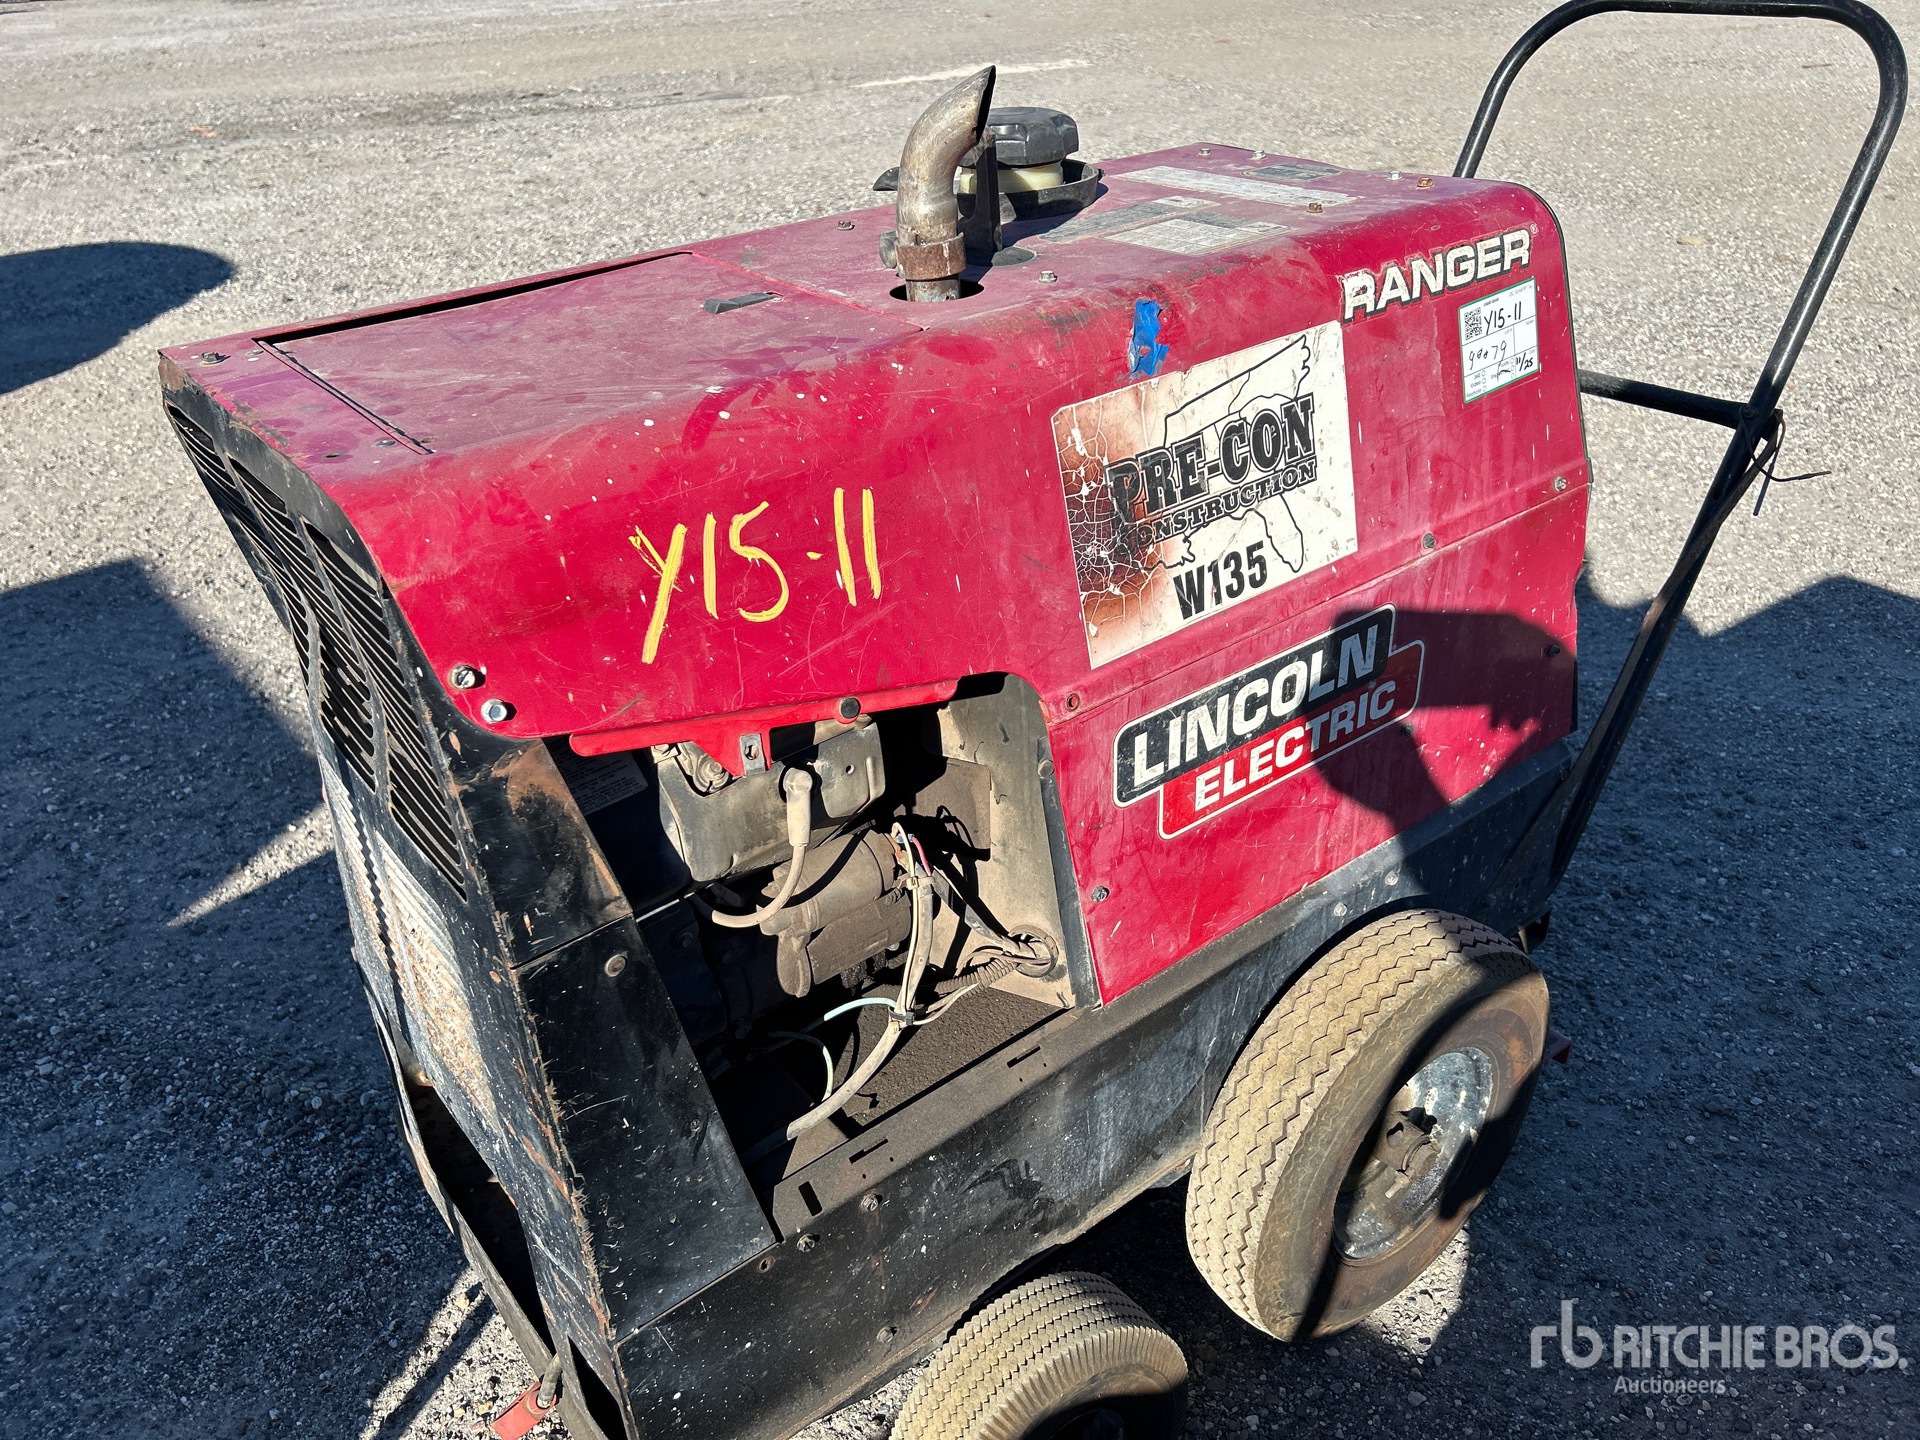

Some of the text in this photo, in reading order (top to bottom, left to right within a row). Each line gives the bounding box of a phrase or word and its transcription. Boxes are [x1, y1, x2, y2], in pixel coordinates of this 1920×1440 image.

[1342, 229, 1532, 322] RANGER
[1484, 301, 1521, 335] Y15-11
[1104, 392, 1314, 524] PRE-CON
[1122, 460, 1317, 548] ONSTRUCTION
[628, 487, 882, 664] Y15-11
[1173, 540, 1268, 620] W135
[1133, 624, 1378, 788] LINCOLN
[1194, 679, 1396, 812] ELECTRIC
